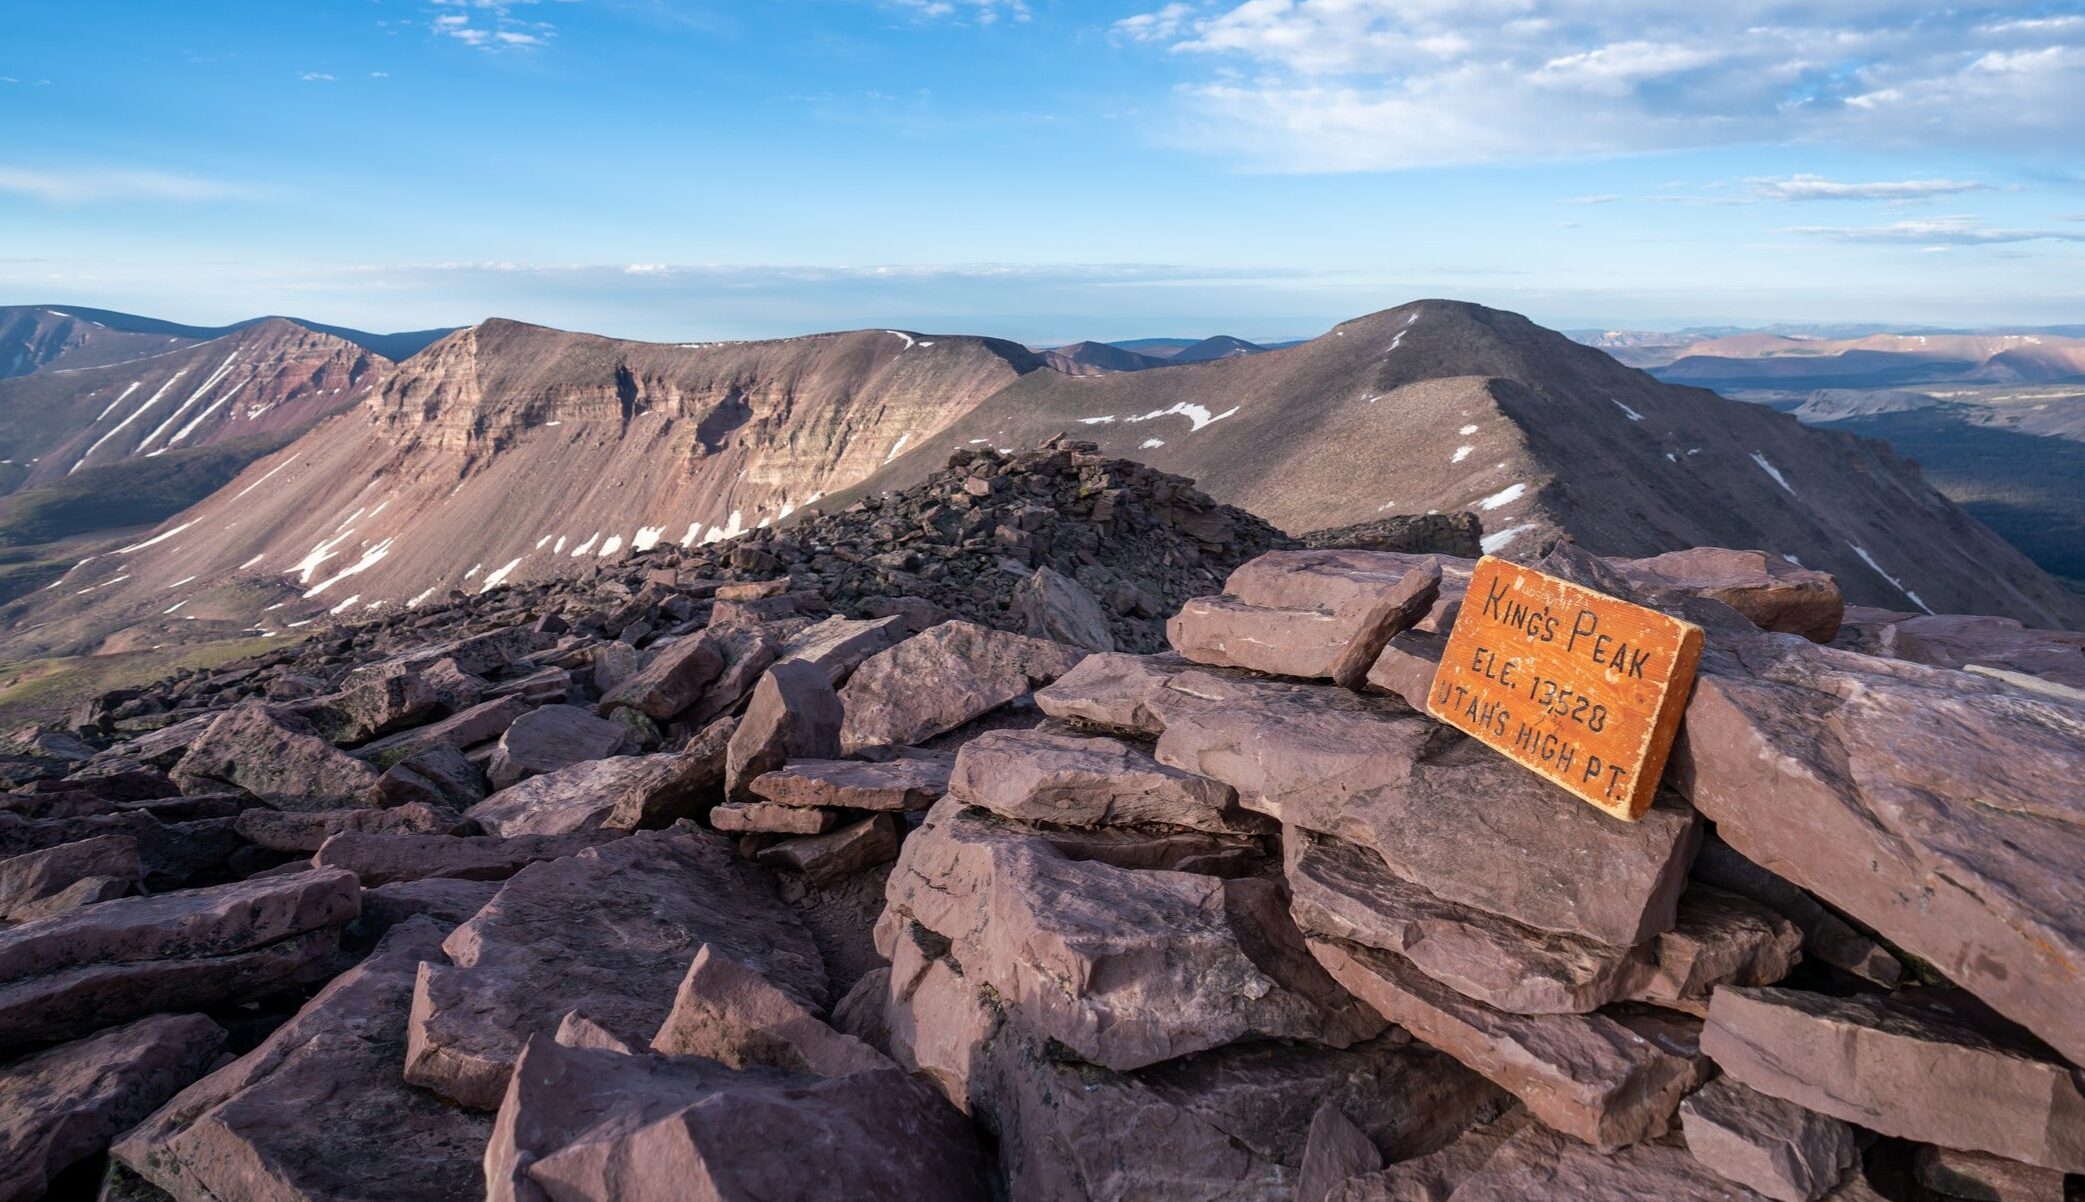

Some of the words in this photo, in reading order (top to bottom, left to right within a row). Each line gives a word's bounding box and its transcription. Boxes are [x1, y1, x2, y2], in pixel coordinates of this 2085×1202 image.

[1483, 576, 1559, 642] KING'S
[1568, 610, 1650, 679] PEAK
[1438, 679, 1510, 736] UTAH'S
[1516, 721, 1576, 773] HIGH
[1583, 756, 1628, 801] PT.
[1472, 647, 1516, 689] ELE.
[1530, 676, 1608, 733] 13,528
